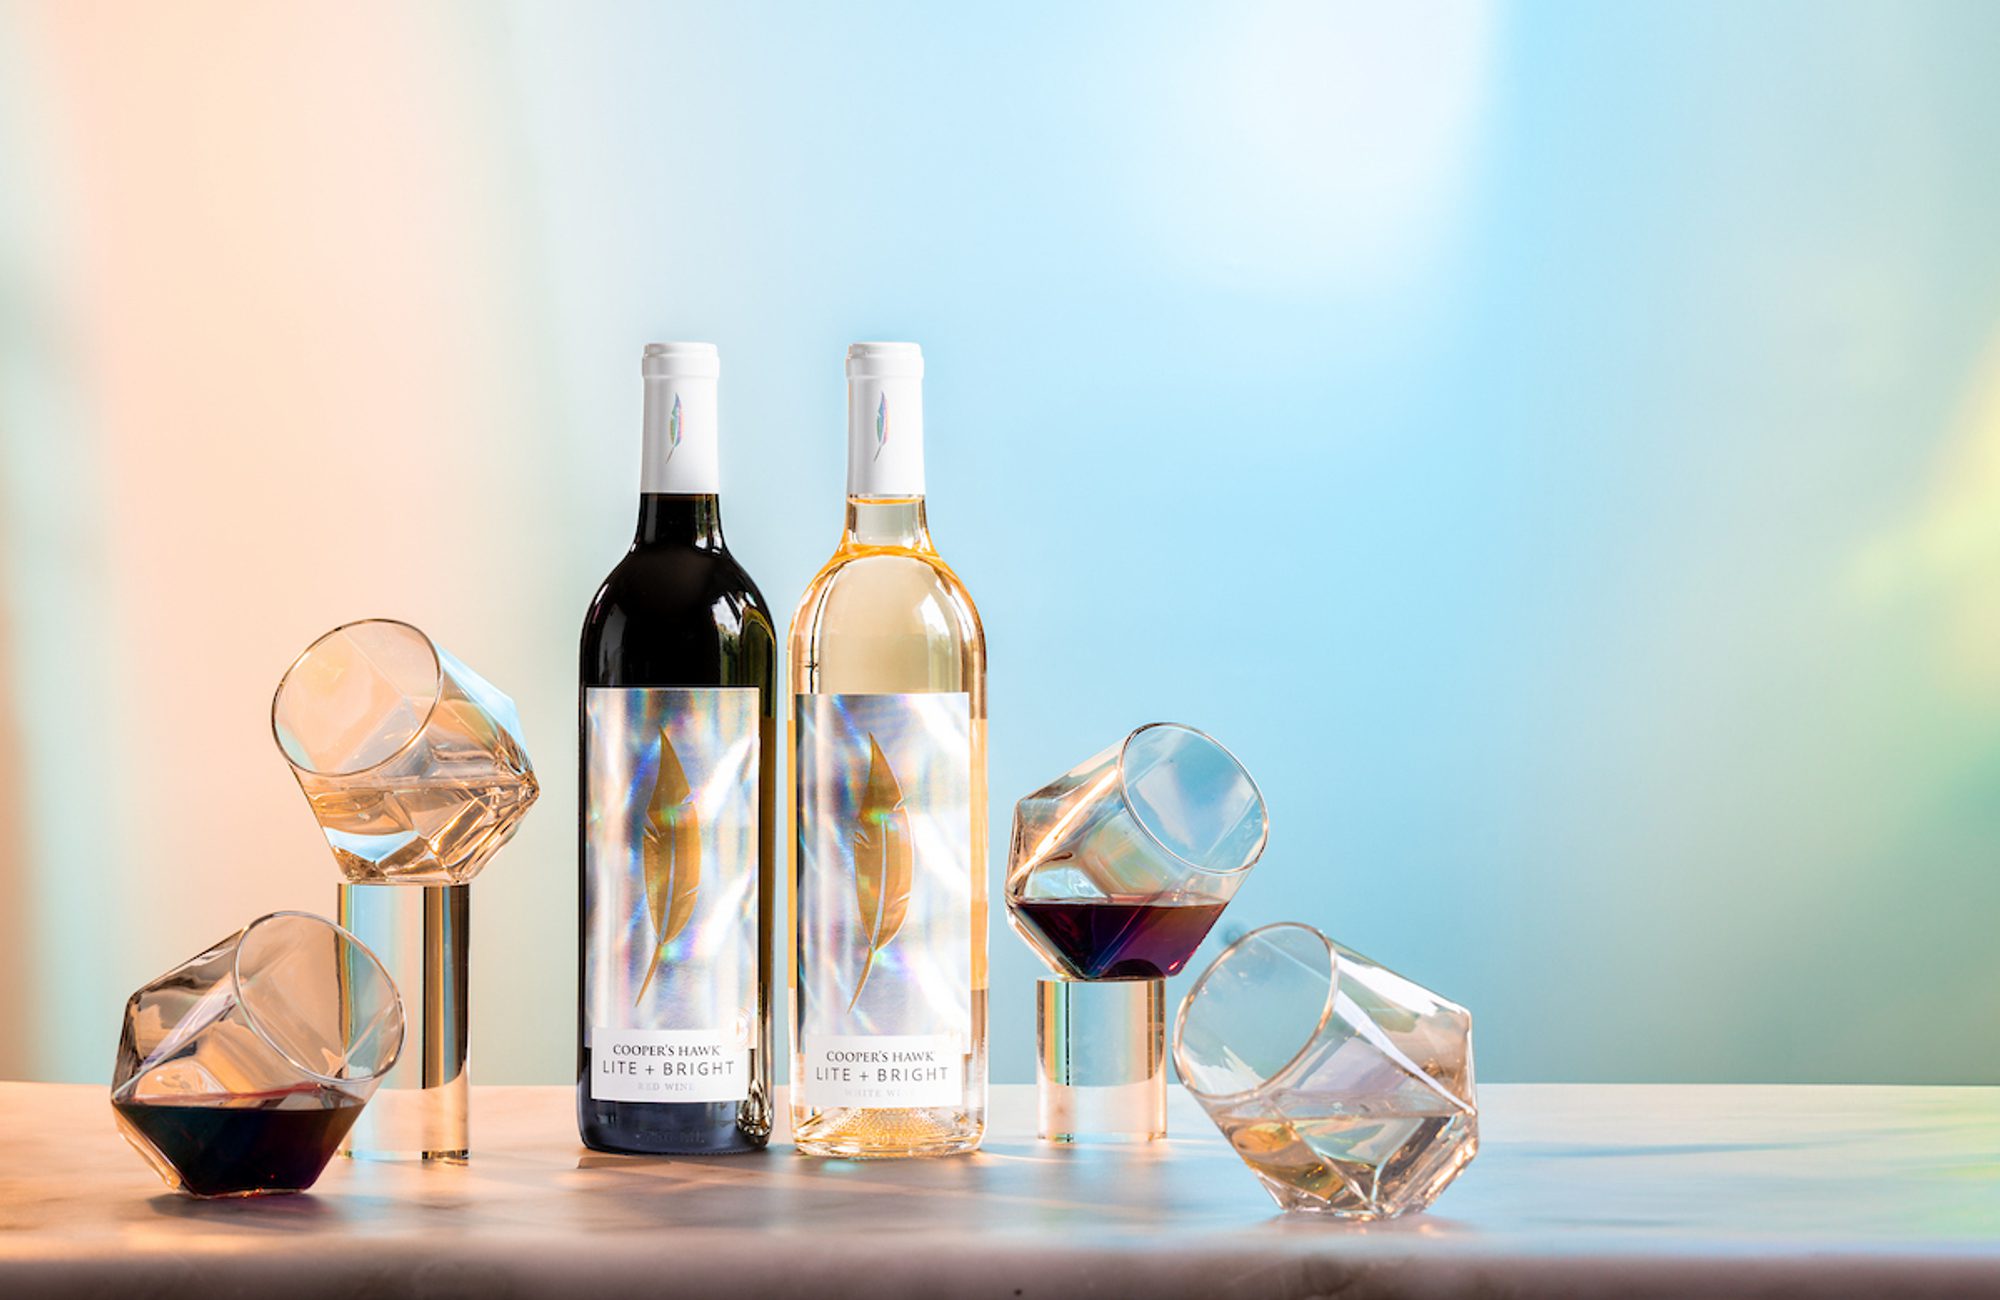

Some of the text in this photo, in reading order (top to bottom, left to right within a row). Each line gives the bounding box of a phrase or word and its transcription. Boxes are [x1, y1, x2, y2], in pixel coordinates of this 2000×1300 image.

[613, 1044, 720, 1056] COOPER'S HAWK
[826, 1050, 934, 1062] COOPER'S HAWK
[603, 1060, 735, 1076] LITE + BRIGHT
[816, 1067, 948, 1082] LITE + BRIGHT
[638, 1082, 660, 1091] RED
